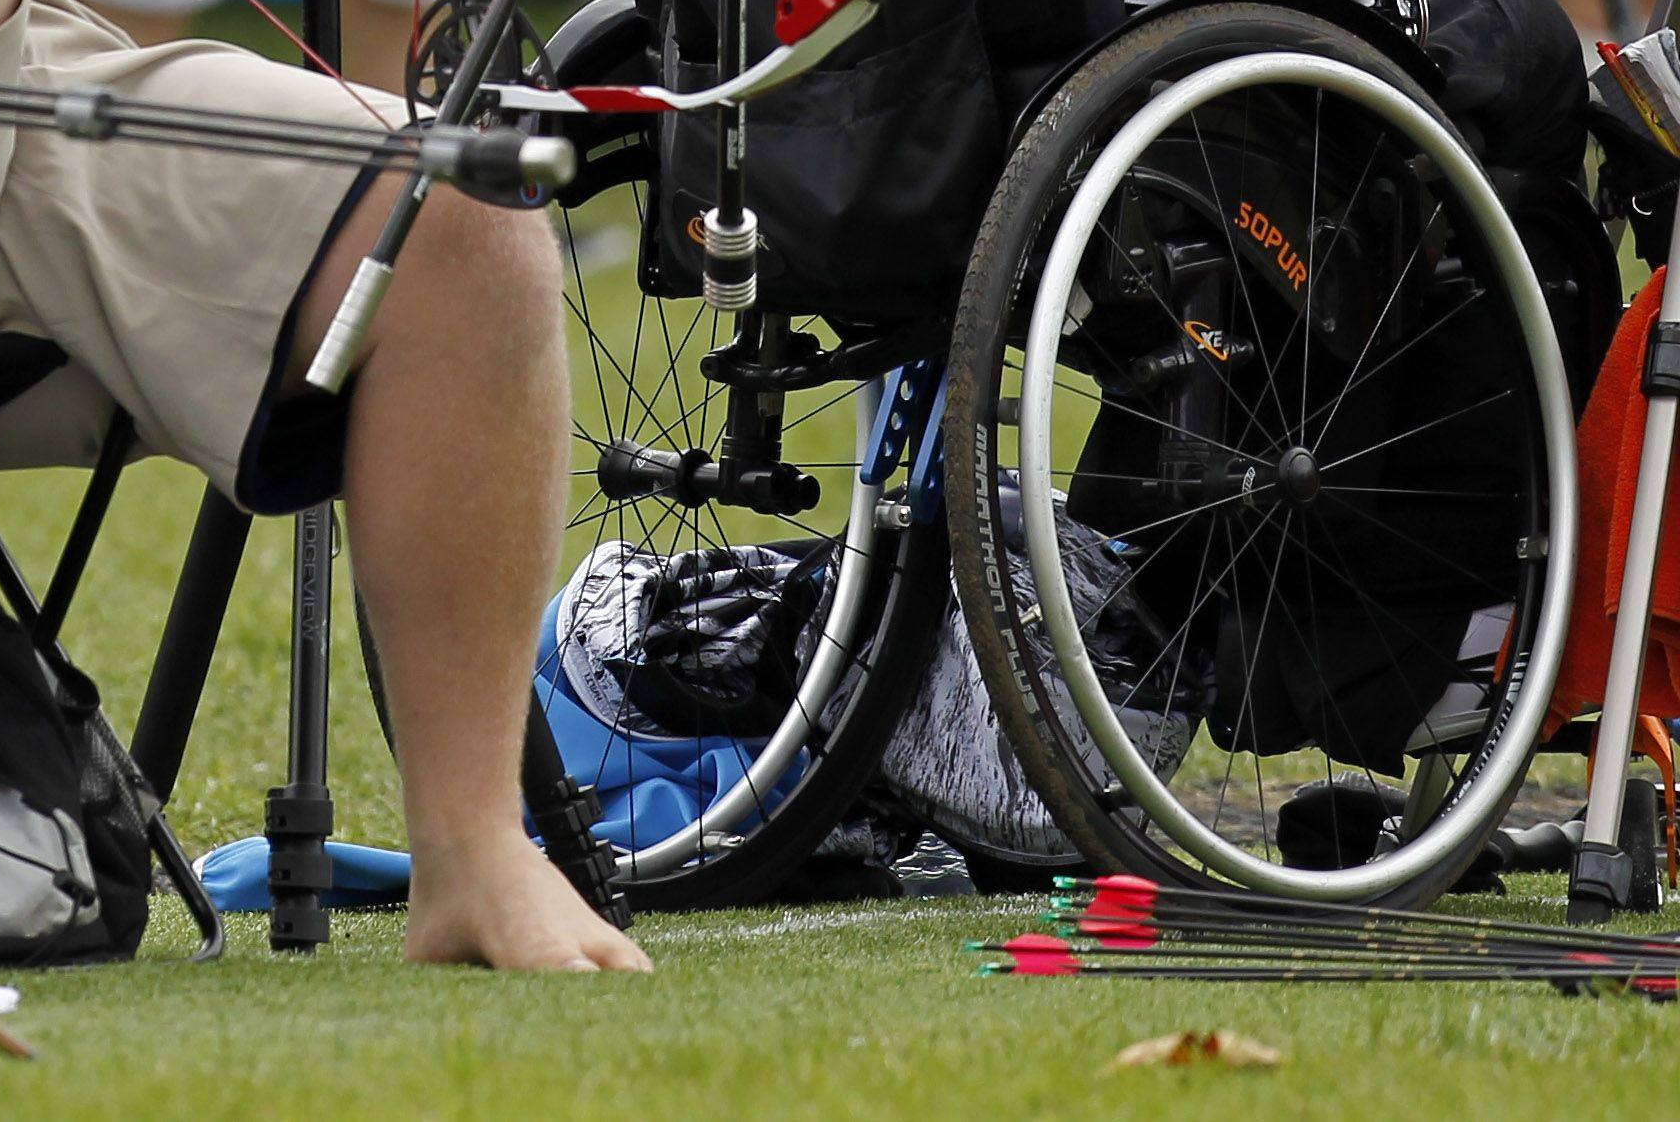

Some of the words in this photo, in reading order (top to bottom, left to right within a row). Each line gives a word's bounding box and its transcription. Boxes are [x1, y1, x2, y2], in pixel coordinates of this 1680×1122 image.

[1234, 201, 1307, 292] SOPUR
[974, 423, 1007, 613] MARATHON
[1000, 628, 1041, 715] PLUS
